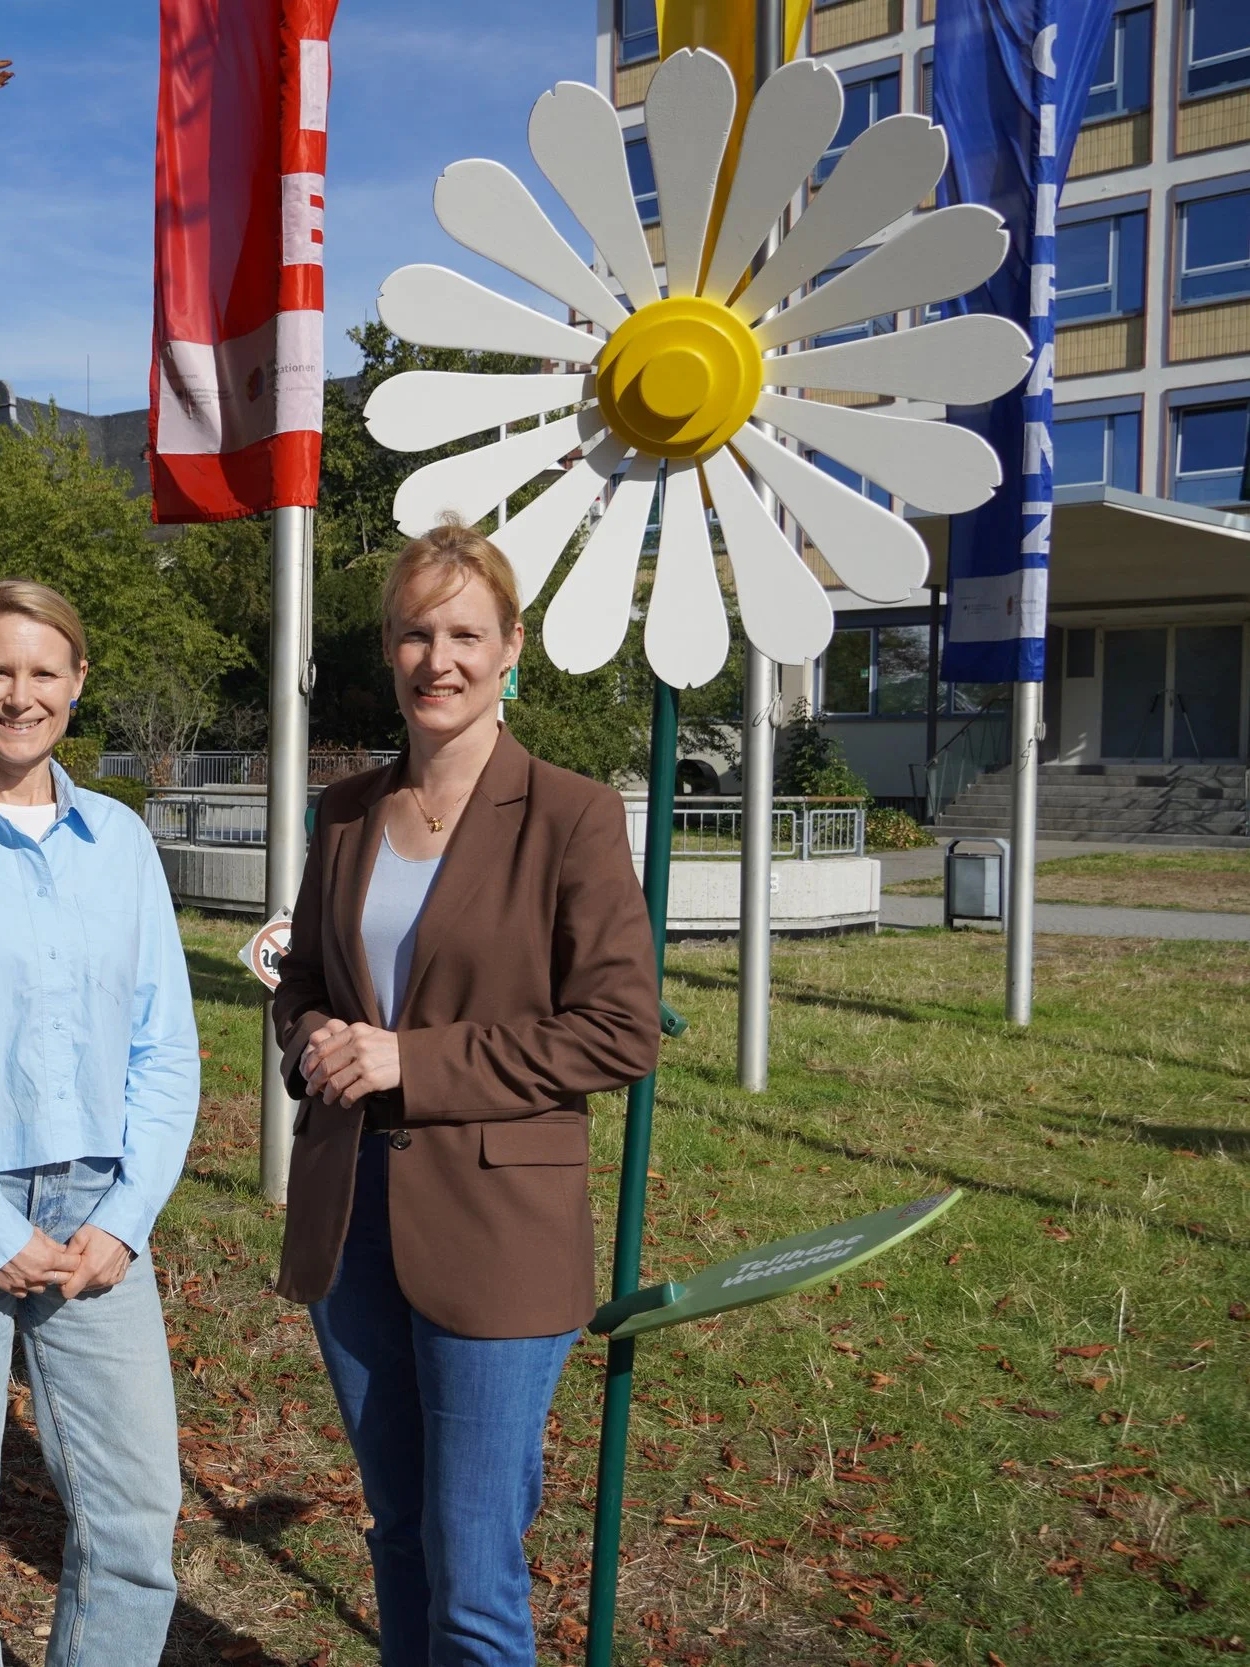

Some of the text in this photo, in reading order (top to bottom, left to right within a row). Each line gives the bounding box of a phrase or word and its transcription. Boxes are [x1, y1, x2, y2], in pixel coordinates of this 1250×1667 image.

[268, 362, 317, 374] rationen
[721, 1246, 853, 1288] Wetterau
[737, 1233, 865, 1274] Teilhabe
